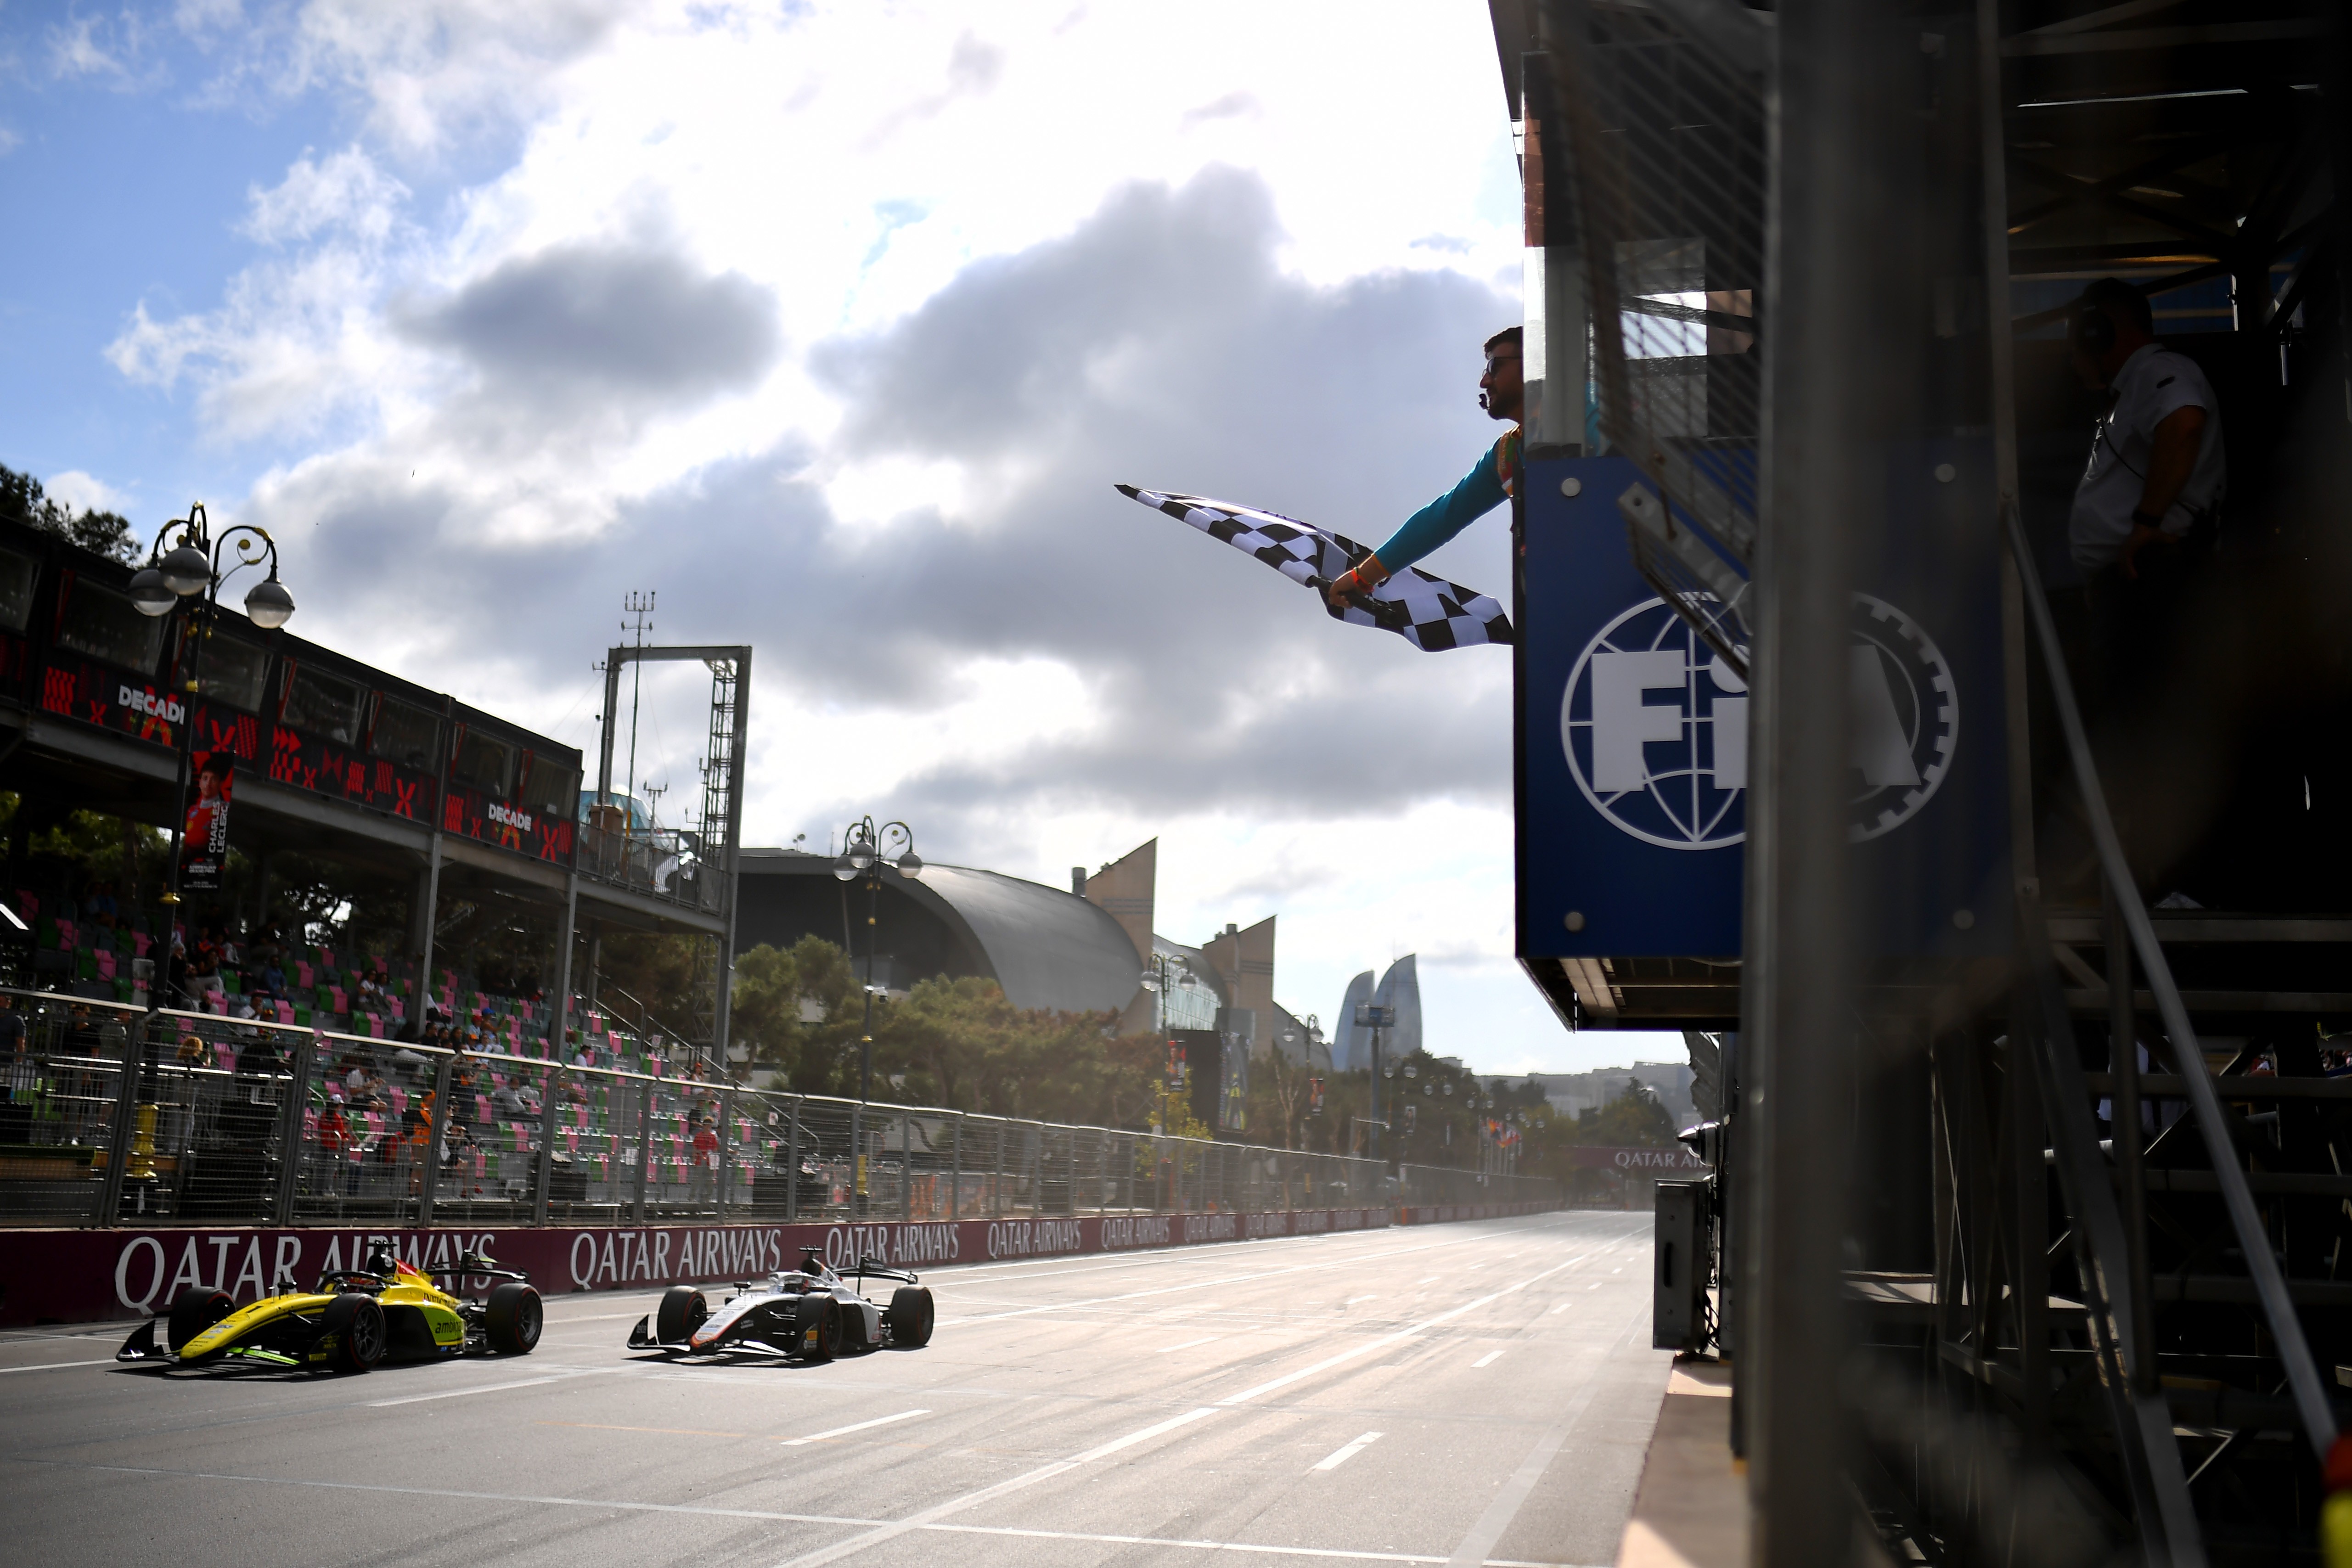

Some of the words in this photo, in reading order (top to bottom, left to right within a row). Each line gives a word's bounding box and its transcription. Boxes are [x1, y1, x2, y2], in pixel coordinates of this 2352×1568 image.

[208, 801, 220, 853] CHARLES
[217, 804, 229, 853] LECLERC
[488, 803, 532, 832] DECADE
[1615, 1152, 1675, 1169] QATAR
[570, 1231, 670, 1290] QATAR
[676, 1229, 781, 1278] AIRWAYS
[826, 1226, 888, 1270] QATAR
[891, 1224, 958, 1263] AIRWAYS
[988, 1222, 1031, 1259] QATAR
[1032, 1220, 1081, 1253] AIRWAYS
[115, 1236, 301, 1315] QATAR
